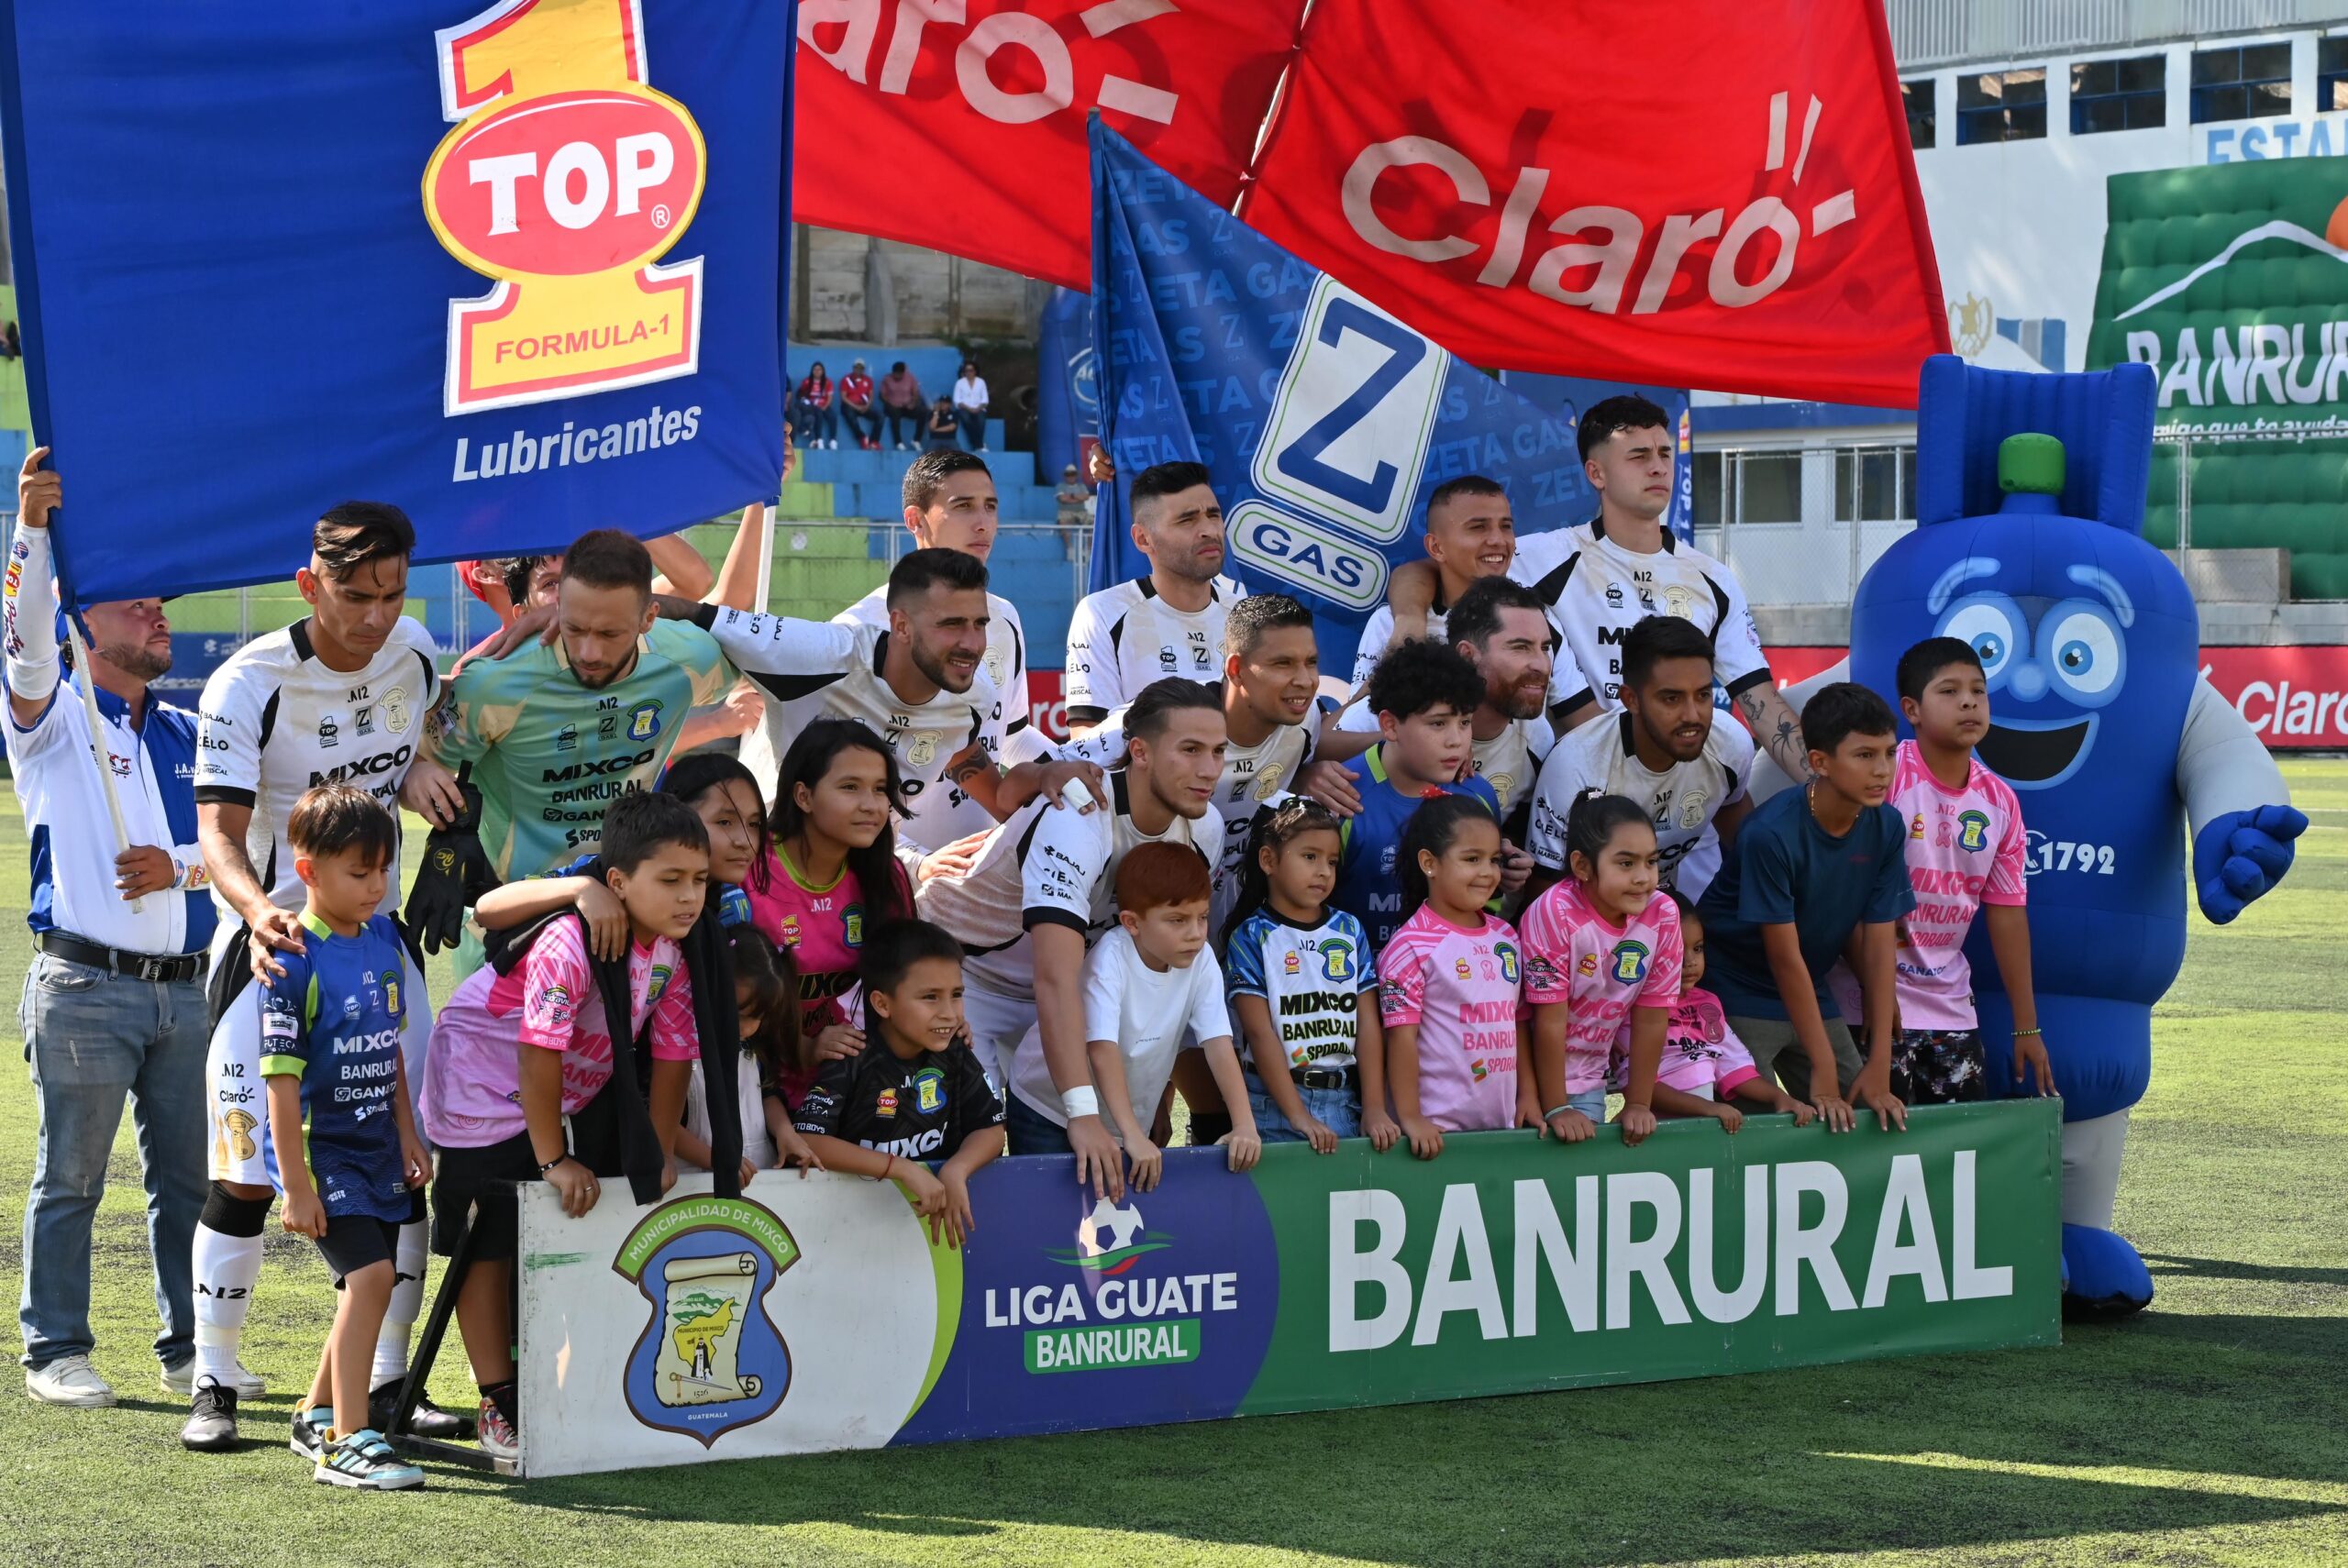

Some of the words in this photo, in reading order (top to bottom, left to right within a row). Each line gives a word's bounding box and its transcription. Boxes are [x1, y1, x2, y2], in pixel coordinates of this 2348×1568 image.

[2208, 119, 2348, 164] ESTA
[469, 131, 674, 237] TOP
[1342, 124, 1807, 315] Claro
[495, 314, 670, 363] FORMULA-1
[1278, 297, 1426, 513] Z
[452, 405, 702, 482] Lubricantes
[1680, 464, 1692, 511] TOP
[1253, 524, 1364, 588] GAS
[321, 726, 338, 734] TOP
[310, 745, 411, 787] MIXCO
[543, 748, 655, 783] MIXCO
[1056, 852, 1086, 877] BAJAJ
[2038, 841, 2115, 875] 1792
[1909, 866, 1987, 896] MIXCO
[783, 927, 799, 935] TOP
[1582, 960, 1595, 969] TOP
[347, 1004, 359, 1012] TOP
[1280, 990, 1357, 1016] MIXCO
[334, 1027, 398, 1055] MIXCO
[341, 1057, 397, 1080] BANRURAL
[220, 1088, 251, 1104] Claro
[859, 1121, 948, 1158] MIXC
[629, 1204, 730, 1262] MUNICIPALIDAD
[732, 1209, 749, 1224] DE
[752, 1217, 790, 1254] MIXCO
[1329, 1150, 2013, 1353] BANRURAL
[986, 1284, 1086, 1327] LIGA
[1096, 1272, 1237, 1320] GUATE
[678, 1326, 702, 1334] MUNICIPIO
[1037, 1325, 1188, 1368] BANRURAL
[694, 1388, 709, 1397] 1526
[688, 1411, 728, 1420] GUATEMALA
